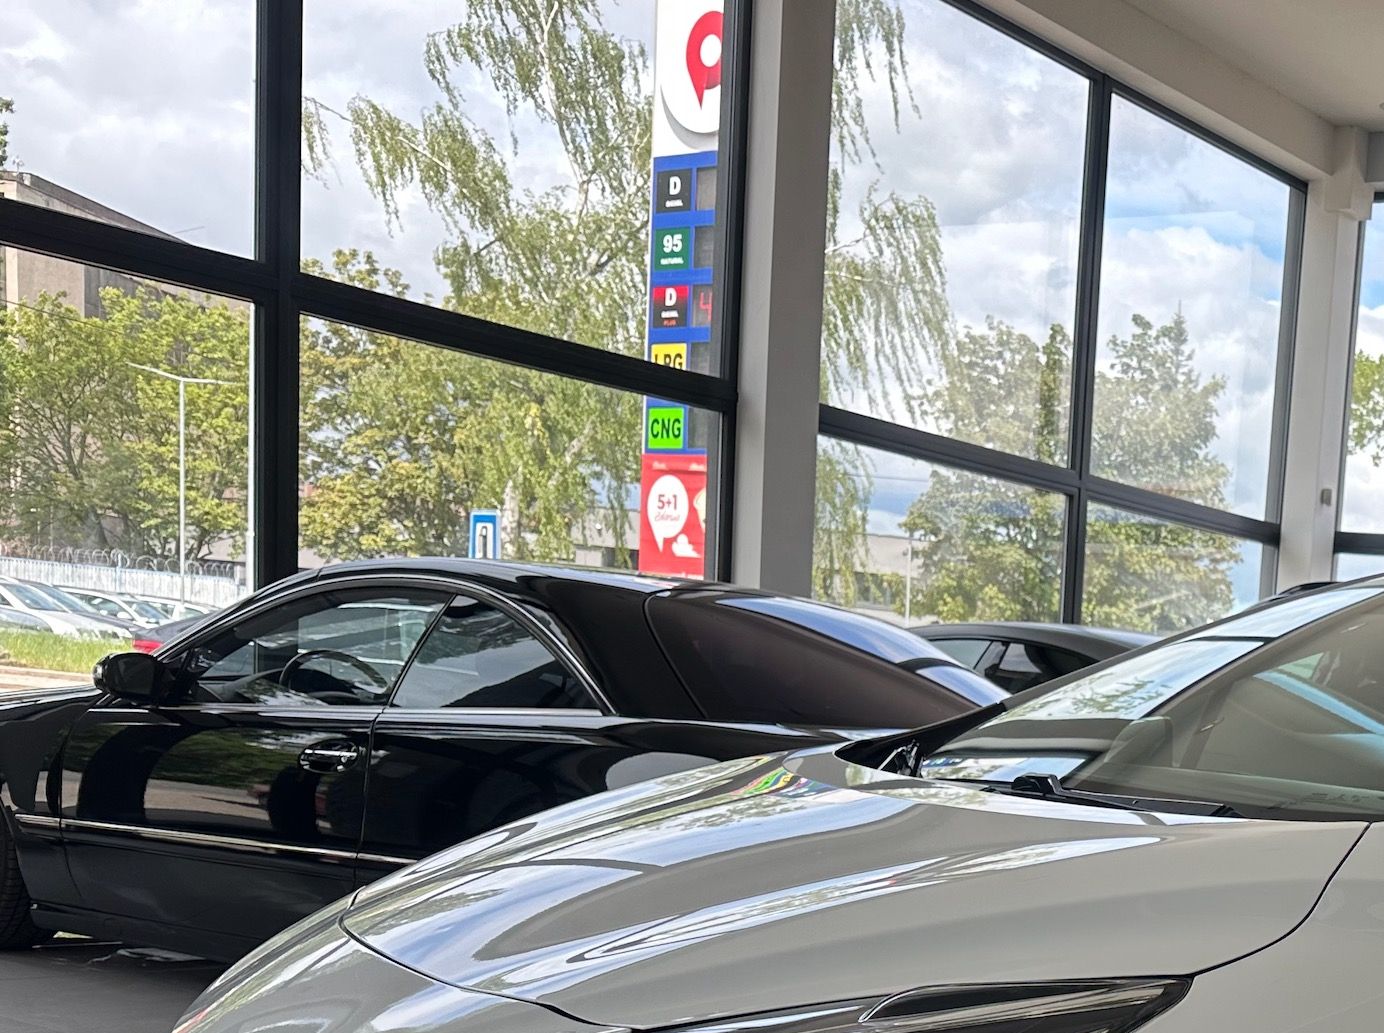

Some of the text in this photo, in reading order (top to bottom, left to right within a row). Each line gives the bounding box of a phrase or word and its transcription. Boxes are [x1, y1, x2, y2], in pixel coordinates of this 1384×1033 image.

[669, 175, 682, 196] D
[662, 233, 683, 253] 95
[664, 287, 677, 307] D
[650, 417, 682, 439] CNG
[657, 494, 678, 511] 5+1
